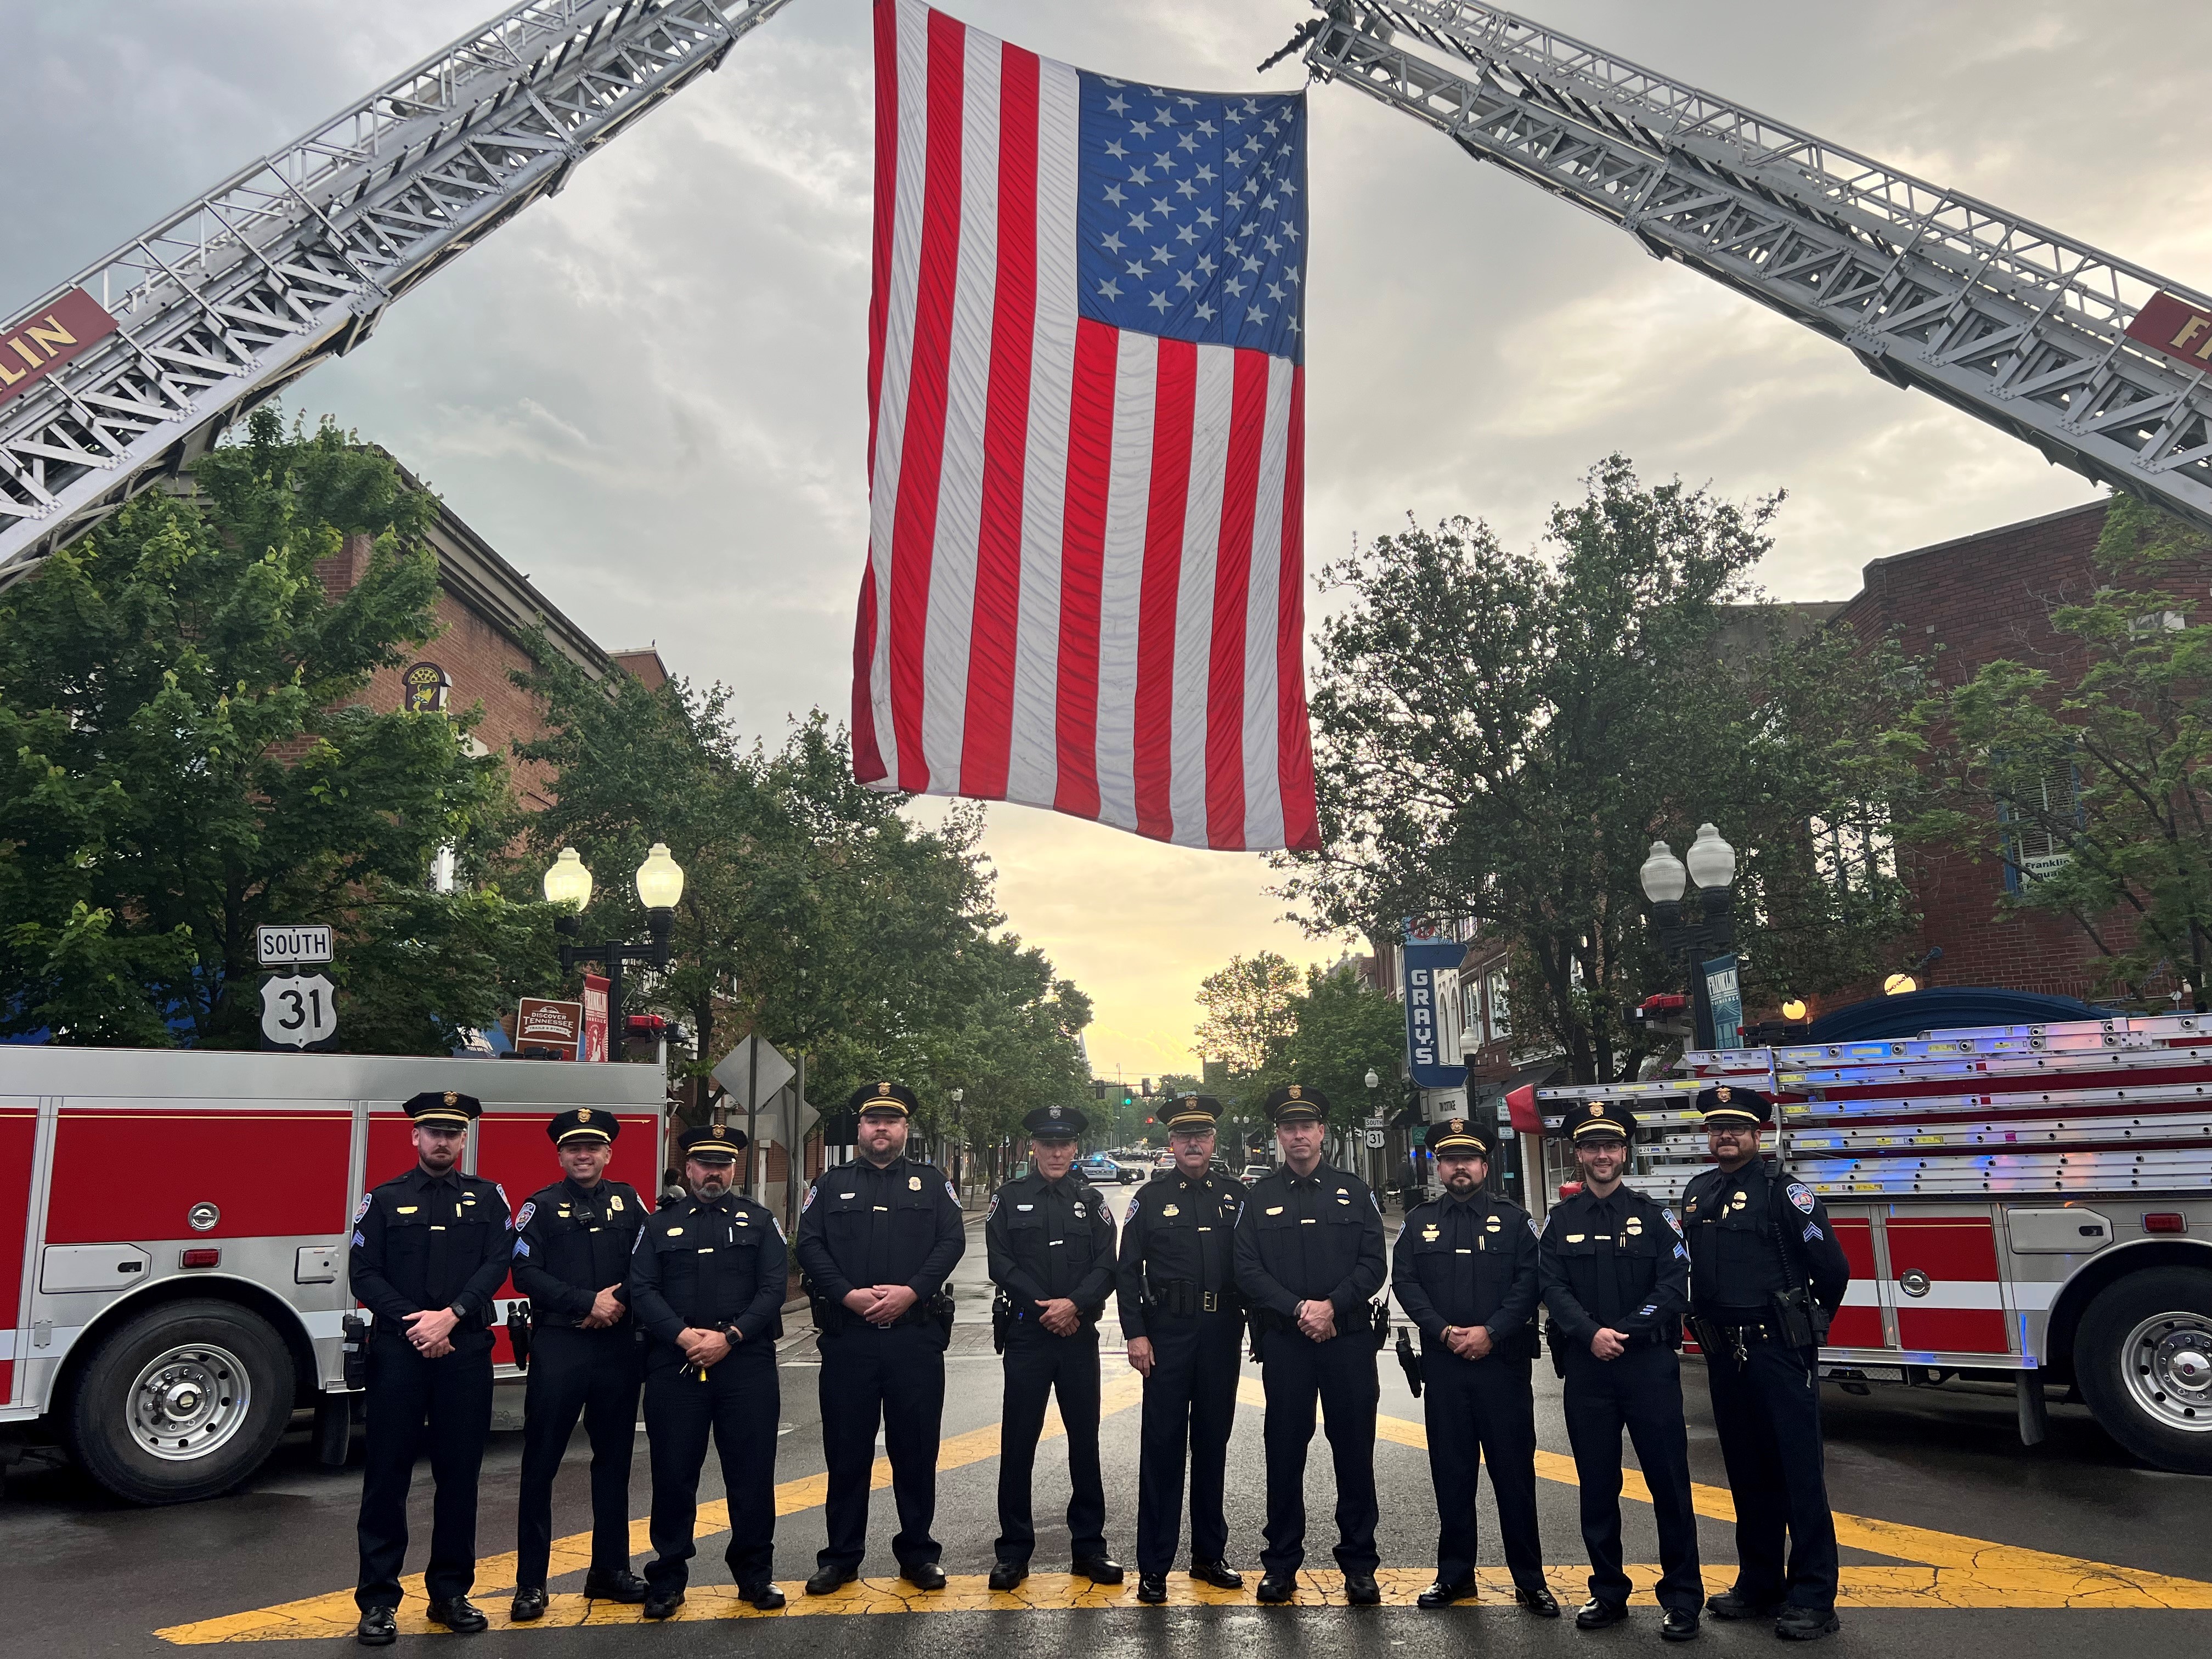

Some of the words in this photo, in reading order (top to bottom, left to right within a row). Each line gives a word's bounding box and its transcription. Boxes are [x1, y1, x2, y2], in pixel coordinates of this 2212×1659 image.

[0, 314, 78, 390] LIN
[264, 934, 326, 955] SOUTH
[1707, 969, 1737, 996] FRANKLIN
[279, 989, 321, 1030] 31
[585, 990, 607, 1013] FRANKLIN
[523, 1016, 574, 1029] TENNESSEE
[1410, 969, 1435, 1064] GRAY'S
[1369, 1133, 1381, 1144] 31
